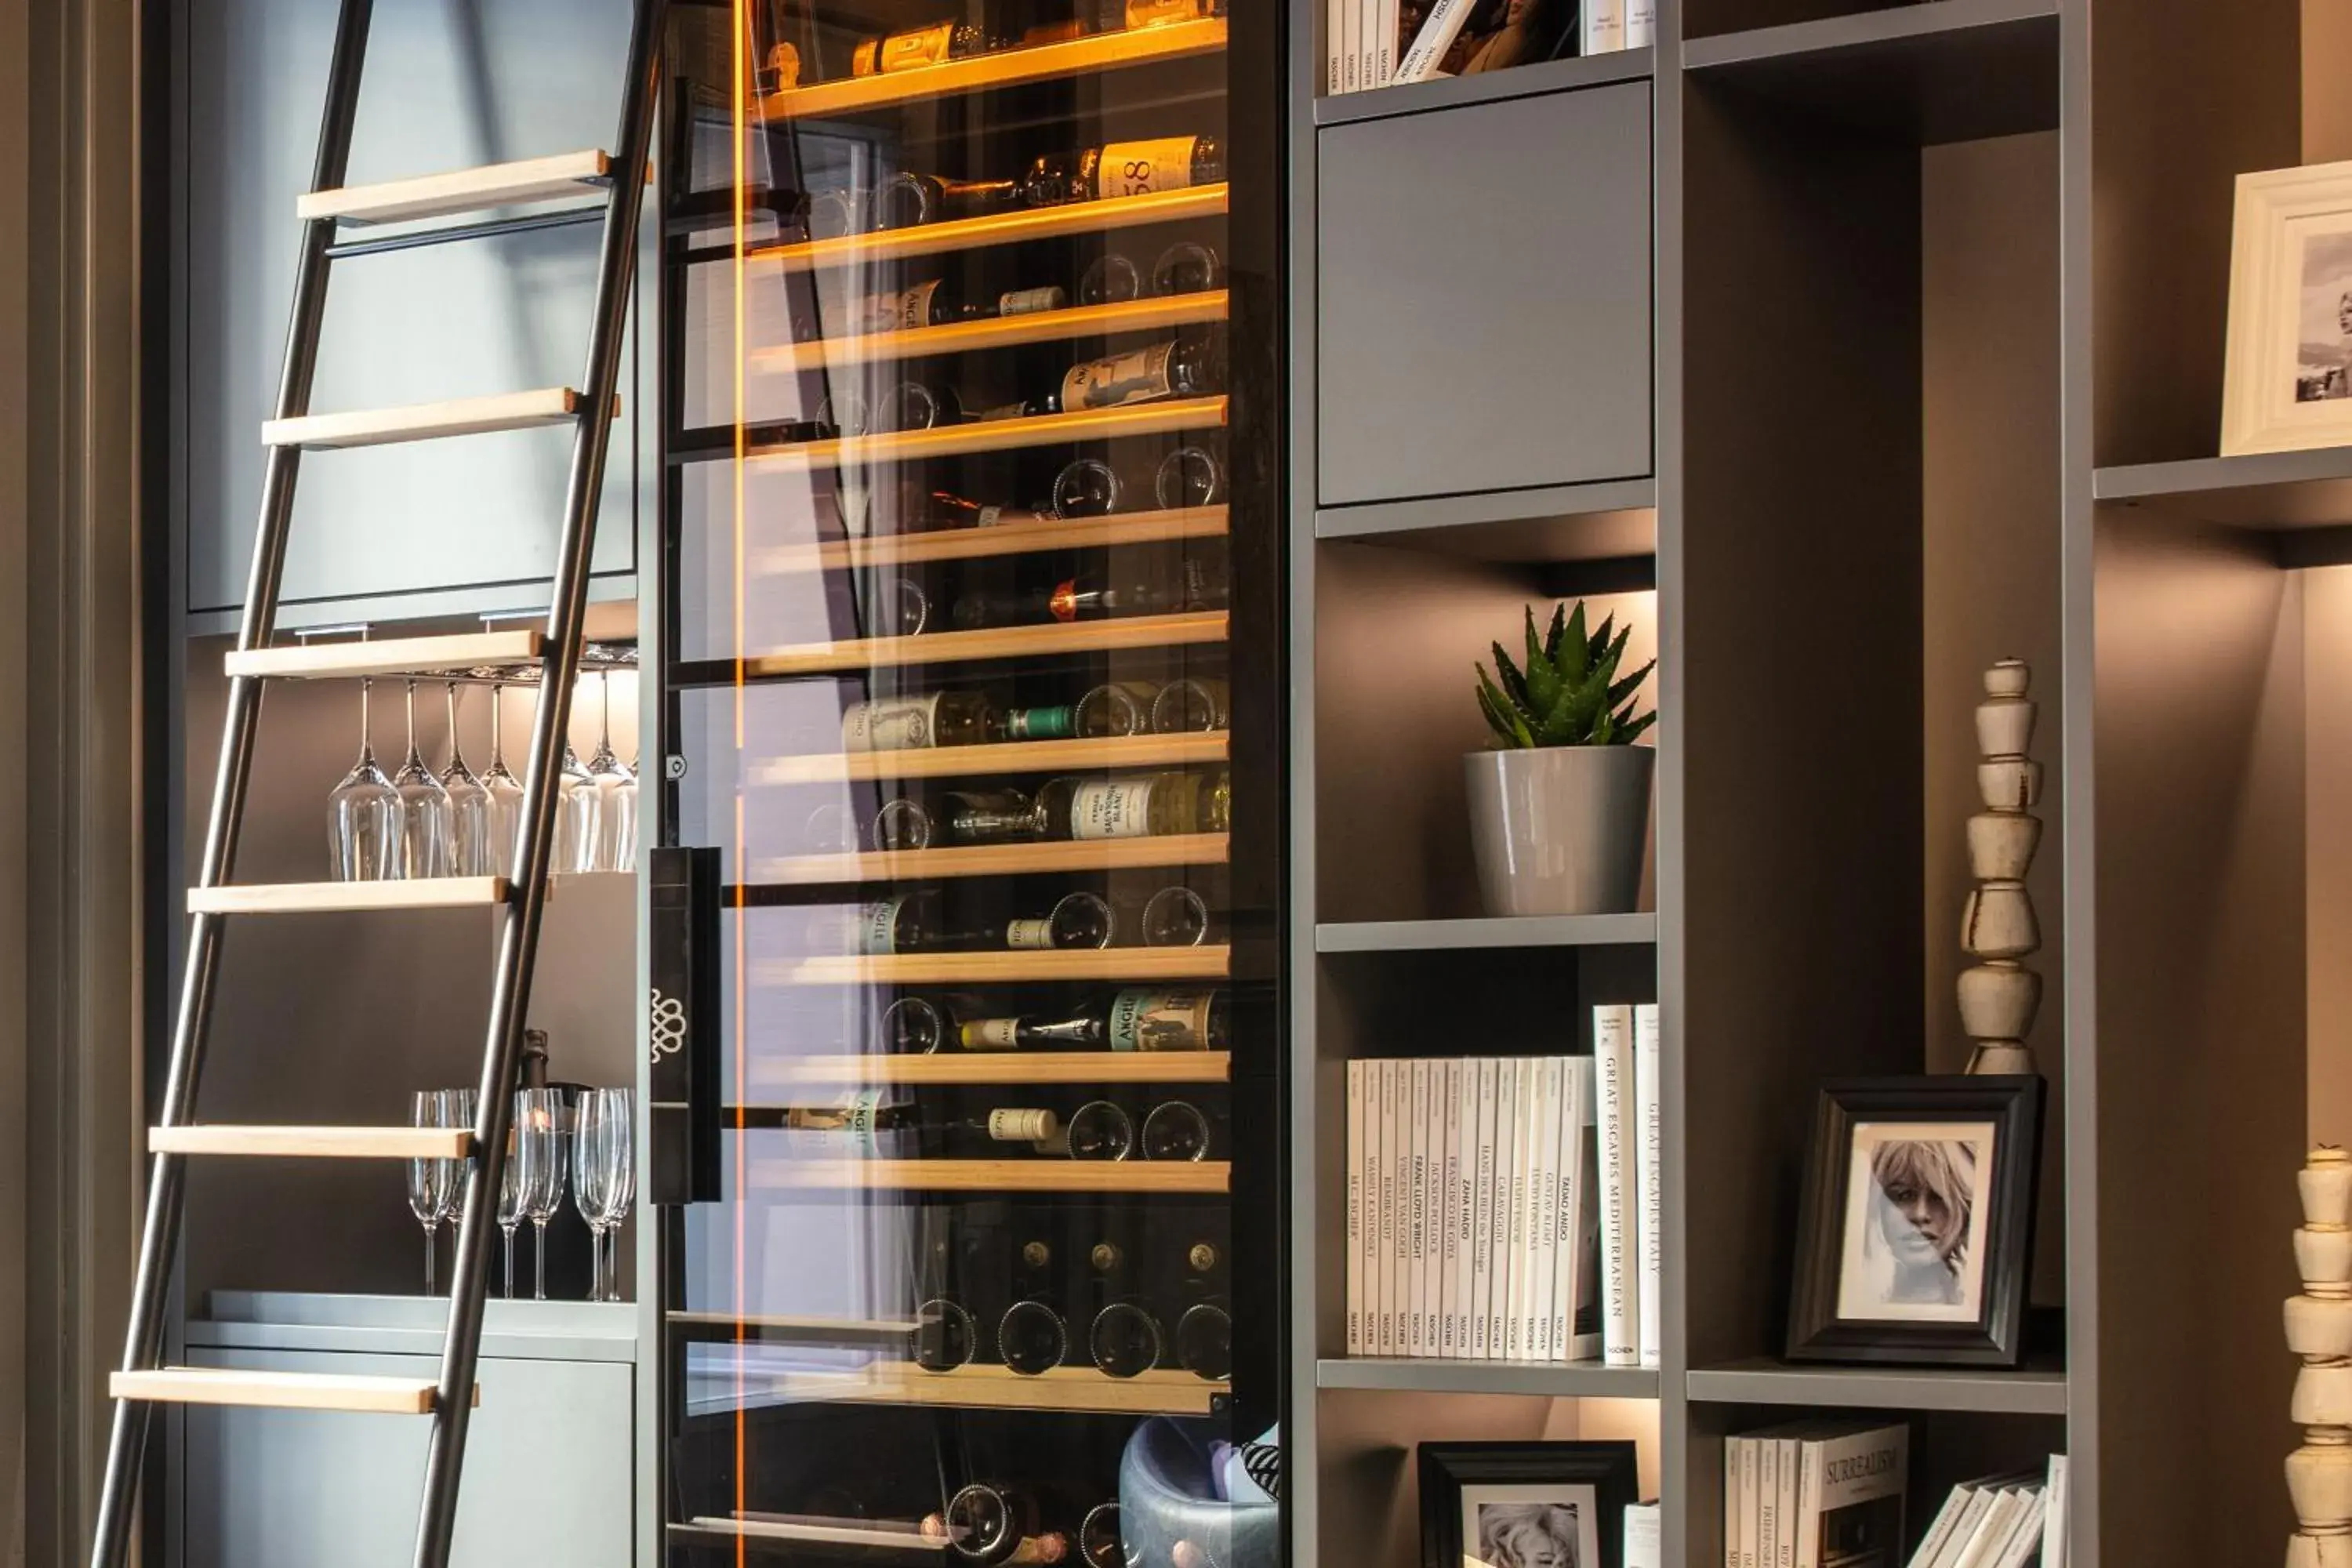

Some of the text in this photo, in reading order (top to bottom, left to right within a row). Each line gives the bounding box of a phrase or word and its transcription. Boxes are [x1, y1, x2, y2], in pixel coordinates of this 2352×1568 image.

[1399, 1156, 1407, 1200] VINCENT
[1414, 1155, 1423, 1185] FRANK
[1480, 1145, 1490, 1174] HANS
[1414, 1189, 1422, 1218] LLOYD
[1447, 1156, 1457, 1214] FRANCISCO
[1462, 1179, 1471, 1205] ZAHA
[1479, 1176, 1488, 1220] HOLBEIN
[1544, 1172, 1555, 1210] GUSTAV
[1606, 1057, 1622, 1317] GREAT ESCAPES MEDITERRANEAN
[1367, 1200, 1375, 1258] KANDINSKY
[1382, 1176, 1392, 1240] REMBRANDT
[1429, 1162, 1439, 1254] JACKSON POLLOCK
[1495, 1176, 1505, 1243] CARAVAGGIO
[1560, 1176, 1570, 1240] TADAO ANDO
[1446, 1232, 1455, 1259] GOYA
[1826, 1447, 1896, 1486] SURREALISM
